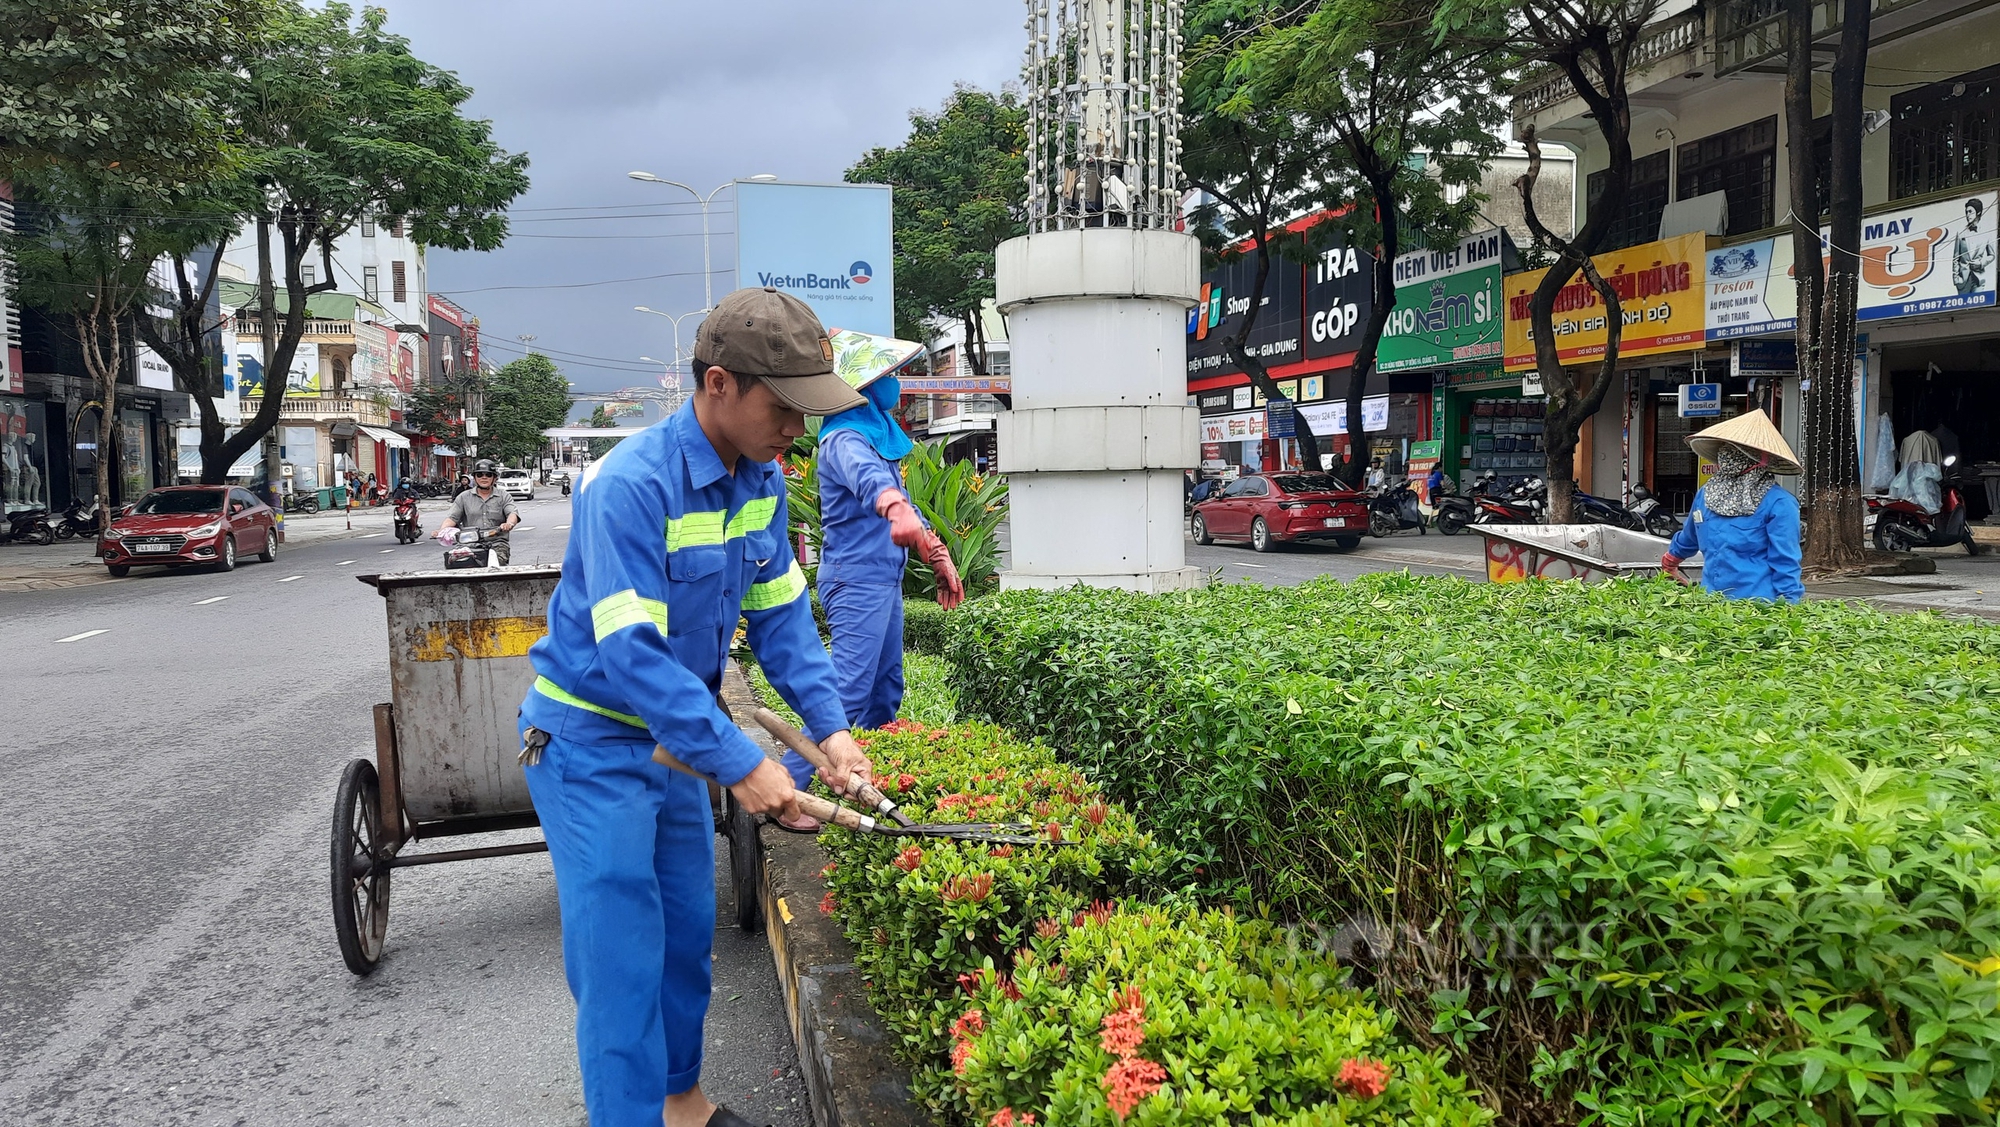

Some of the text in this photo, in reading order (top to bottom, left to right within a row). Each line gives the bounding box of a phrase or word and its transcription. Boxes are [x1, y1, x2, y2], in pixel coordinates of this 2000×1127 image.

[1865, 217, 1913, 241] MAY
[1395, 256, 1426, 284] NỆM
[1466, 235, 1499, 264] HÀN
[1714, 280, 1755, 296] Veston
[1227, 296, 1251, 316] Shop
[1474, 277, 1493, 324] SỈ
[1719, 299, 1734, 310] PHỤC
[1735, 296, 1748, 308] NAM
[1749, 293, 1759, 304] NỮ
[1919, 295, 1986, 311] 0987.200.409
[1311, 297, 1358, 342] GÓP
[1583, 317, 1607, 331] GIA
[1647, 302, 1671, 324] ĐỘ
[1731, 311, 1750, 321] TRANG
[1745, 321, 1765, 334] HÙNG
[1766, 320, 1792, 331] VƯƠNG
[1188, 356, 1202, 374] ĐIỆN
[1203, 354, 1222, 370] THOẠI
[1261, 343, 1274, 357] GIA
[1274, 338, 1298, 356] DỤNG
[142, 360, 170, 373] LOCAL BRAND
[1279, 385, 1296, 397] cer
[1203, 395, 1227, 408] SAMSUNG
[1688, 402, 1717, 410] essilor
[1321, 411, 1330, 421] S24
[1331, 410, 1336, 420] FE
[1207, 426, 1224, 441] 10%
